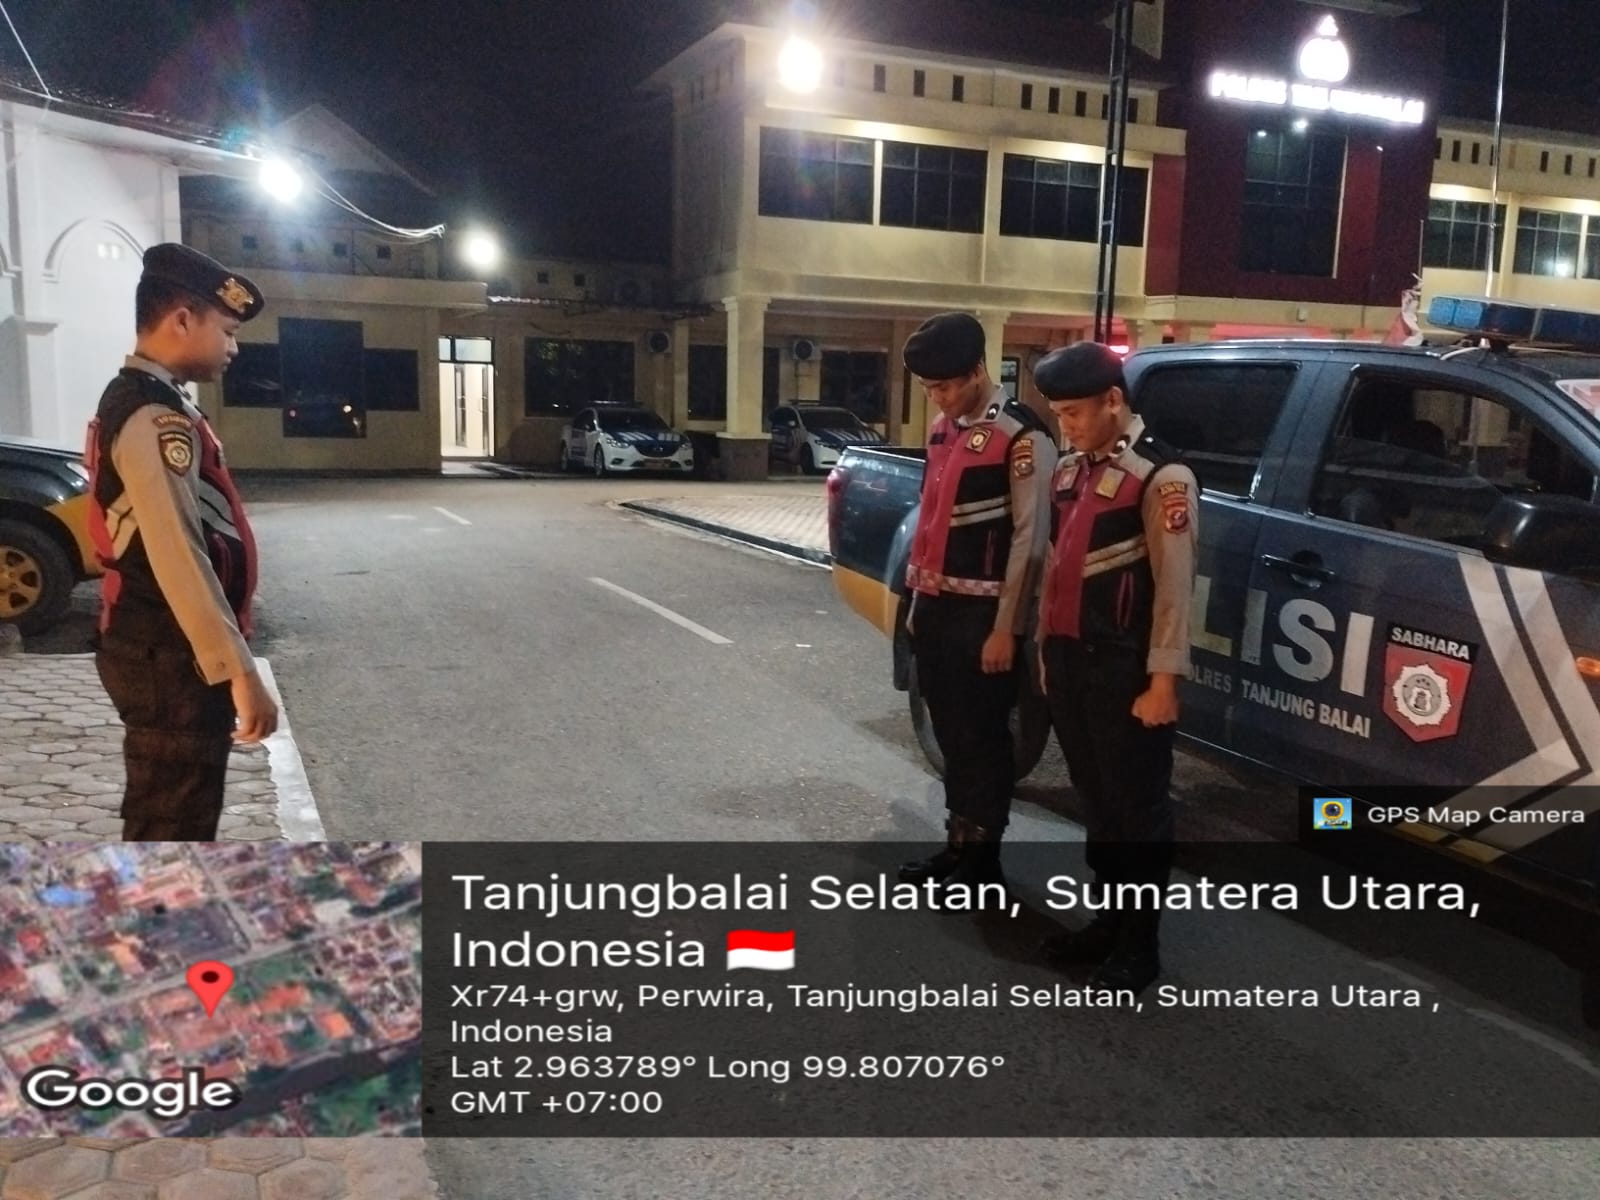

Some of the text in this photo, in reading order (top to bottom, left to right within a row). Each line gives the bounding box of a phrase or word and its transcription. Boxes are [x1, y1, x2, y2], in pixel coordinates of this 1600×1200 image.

[1189, 575, 1375, 698] LISI
[1391, 627, 1470, 661] SABHARA
[1187, 664, 1371, 739] OLRES TANJUNG BALAI
